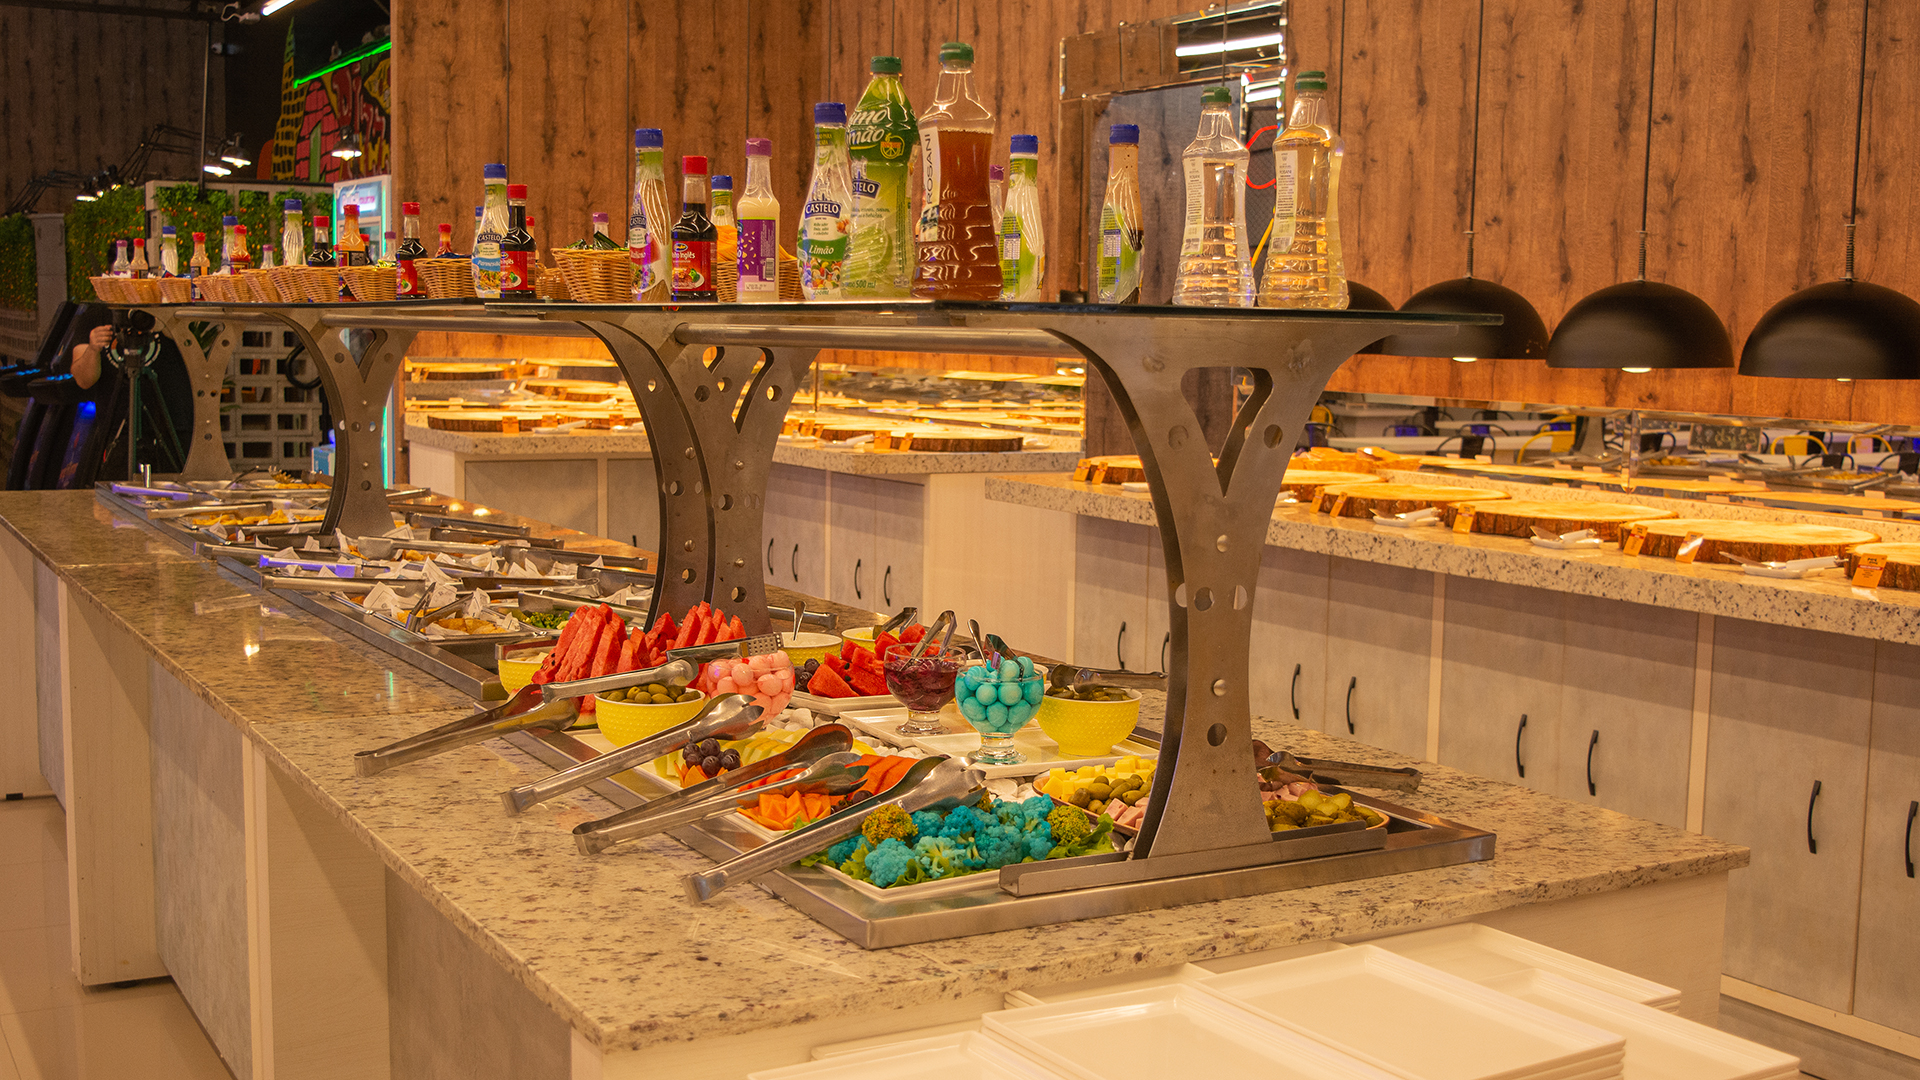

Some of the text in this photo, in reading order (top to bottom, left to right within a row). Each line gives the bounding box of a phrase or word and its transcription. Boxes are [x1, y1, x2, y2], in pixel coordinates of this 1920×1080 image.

[848, 108, 887, 127] umo
[847, 125, 885, 145] mão
[924, 133, 933, 204] ROSANI
[852, 181, 876, 194] STELO
[805, 203, 839, 214] CASTELO
[478, 234, 501, 242] CASTELO
[809, 244, 834, 255] Limão
[856, 279, 867, 288] 500
